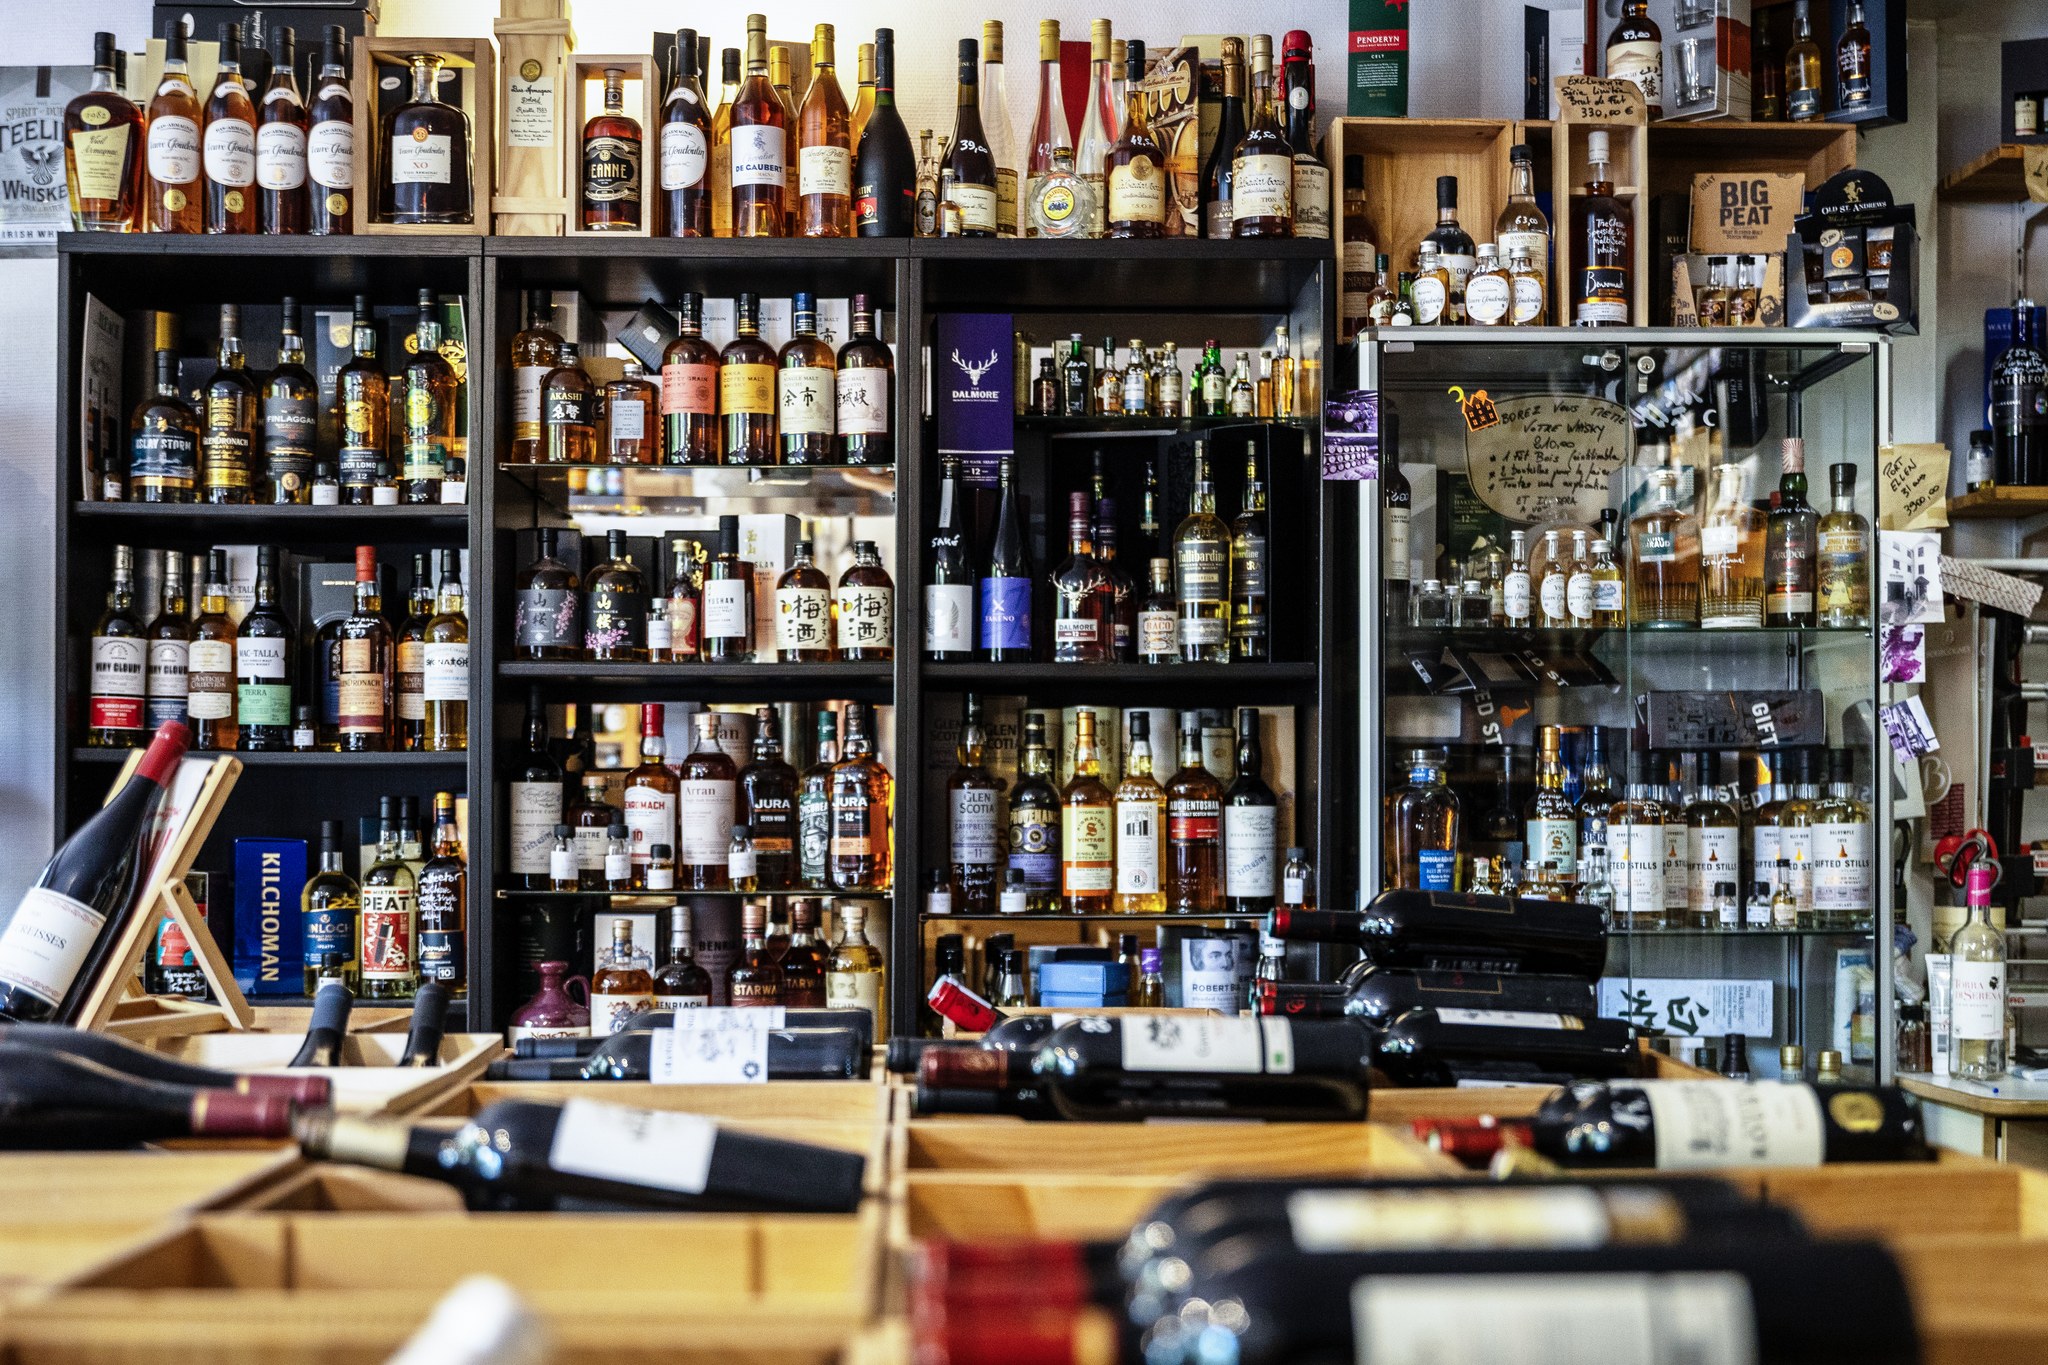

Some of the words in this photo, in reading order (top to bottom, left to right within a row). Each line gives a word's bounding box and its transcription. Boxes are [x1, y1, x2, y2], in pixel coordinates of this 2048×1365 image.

[1357, 36, 1400, 44] PENDERYN
[6, 106, 39, 120] SPIRIT
[1582, 107, 1620, 119] 330,00
[1625, 106, 1634, 115] €
[0, 119, 65, 153] TEELI
[960, 139, 988, 154] 39,00
[413, 161, 429, 170] XO
[735, 164, 744, 172] DE
[745, 164, 783, 173] GAUBERT
[2, 180, 68, 203] WHISKE
[1720, 180, 1769, 207] BIG
[1821, 206, 1838, 215] OLD
[1852, 201, 1887, 212] ANDREWS
[1515, 215, 1538, 226] 63,00
[1720, 205, 1773, 227] PEAT
[1, 230, 33, 239] IRISH
[1677, 314, 1697, 325] BIG
[550, 392, 582, 401] AKASHI
[783, 387, 817, 407] 余市
[952, 391, 999, 399] DALMORE
[1501, 405, 1541, 424] BOREZ
[267, 416, 315, 425] FINLAGGAN
[136, 438, 159, 449] ISLAY
[160, 439, 192, 451] STORM
[202, 437, 249, 447] GLENDRONACH
[340, 462, 356, 470] LOCH
[1882, 456, 1903, 479] PORT
[1890, 458, 1917, 492] ELLEN
[1178, 549, 1227, 562] Tullibardine
[791, 594, 822, 643] 梅酒
[853, 593, 883, 642] 梅酒
[985, 615, 1015, 623] TAKENO
[239, 649, 279, 658] MAC-TALLA
[95, 663, 112, 674] VERY
[113, 663, 142, 674] CLOUDY
[1751, 701, 1778, 746] GIFT
[832, 796, 868, 807] JURA
[964, 791, 991, 803] GLEN
[755, 799, 791, 809] JURA
[960, 803, 995, 814] SCOTIA
[1170, 801, 1220, 811] AUCHENTOSHAN
[844, 813, 854, 822] 12
[633, 831, 643, 841] 10
[974, 848, 983, 858] 11
[1237, 853, 1267, 875] EXCLUSIVE
[1630, 862, 1657, 870] STILLS
[1815, 860, 1841, 868] GIFTED
[1845, 860, 1870, 868] STILLS
[1134, 875, 1141, 883] 8
[364, 896, 409, 911] PEAT
[261, 852, 281, 982] KILCHOMAN
[439, 968, 452, 978] 10
[1192, 983, 1229, 992] ROBERT
